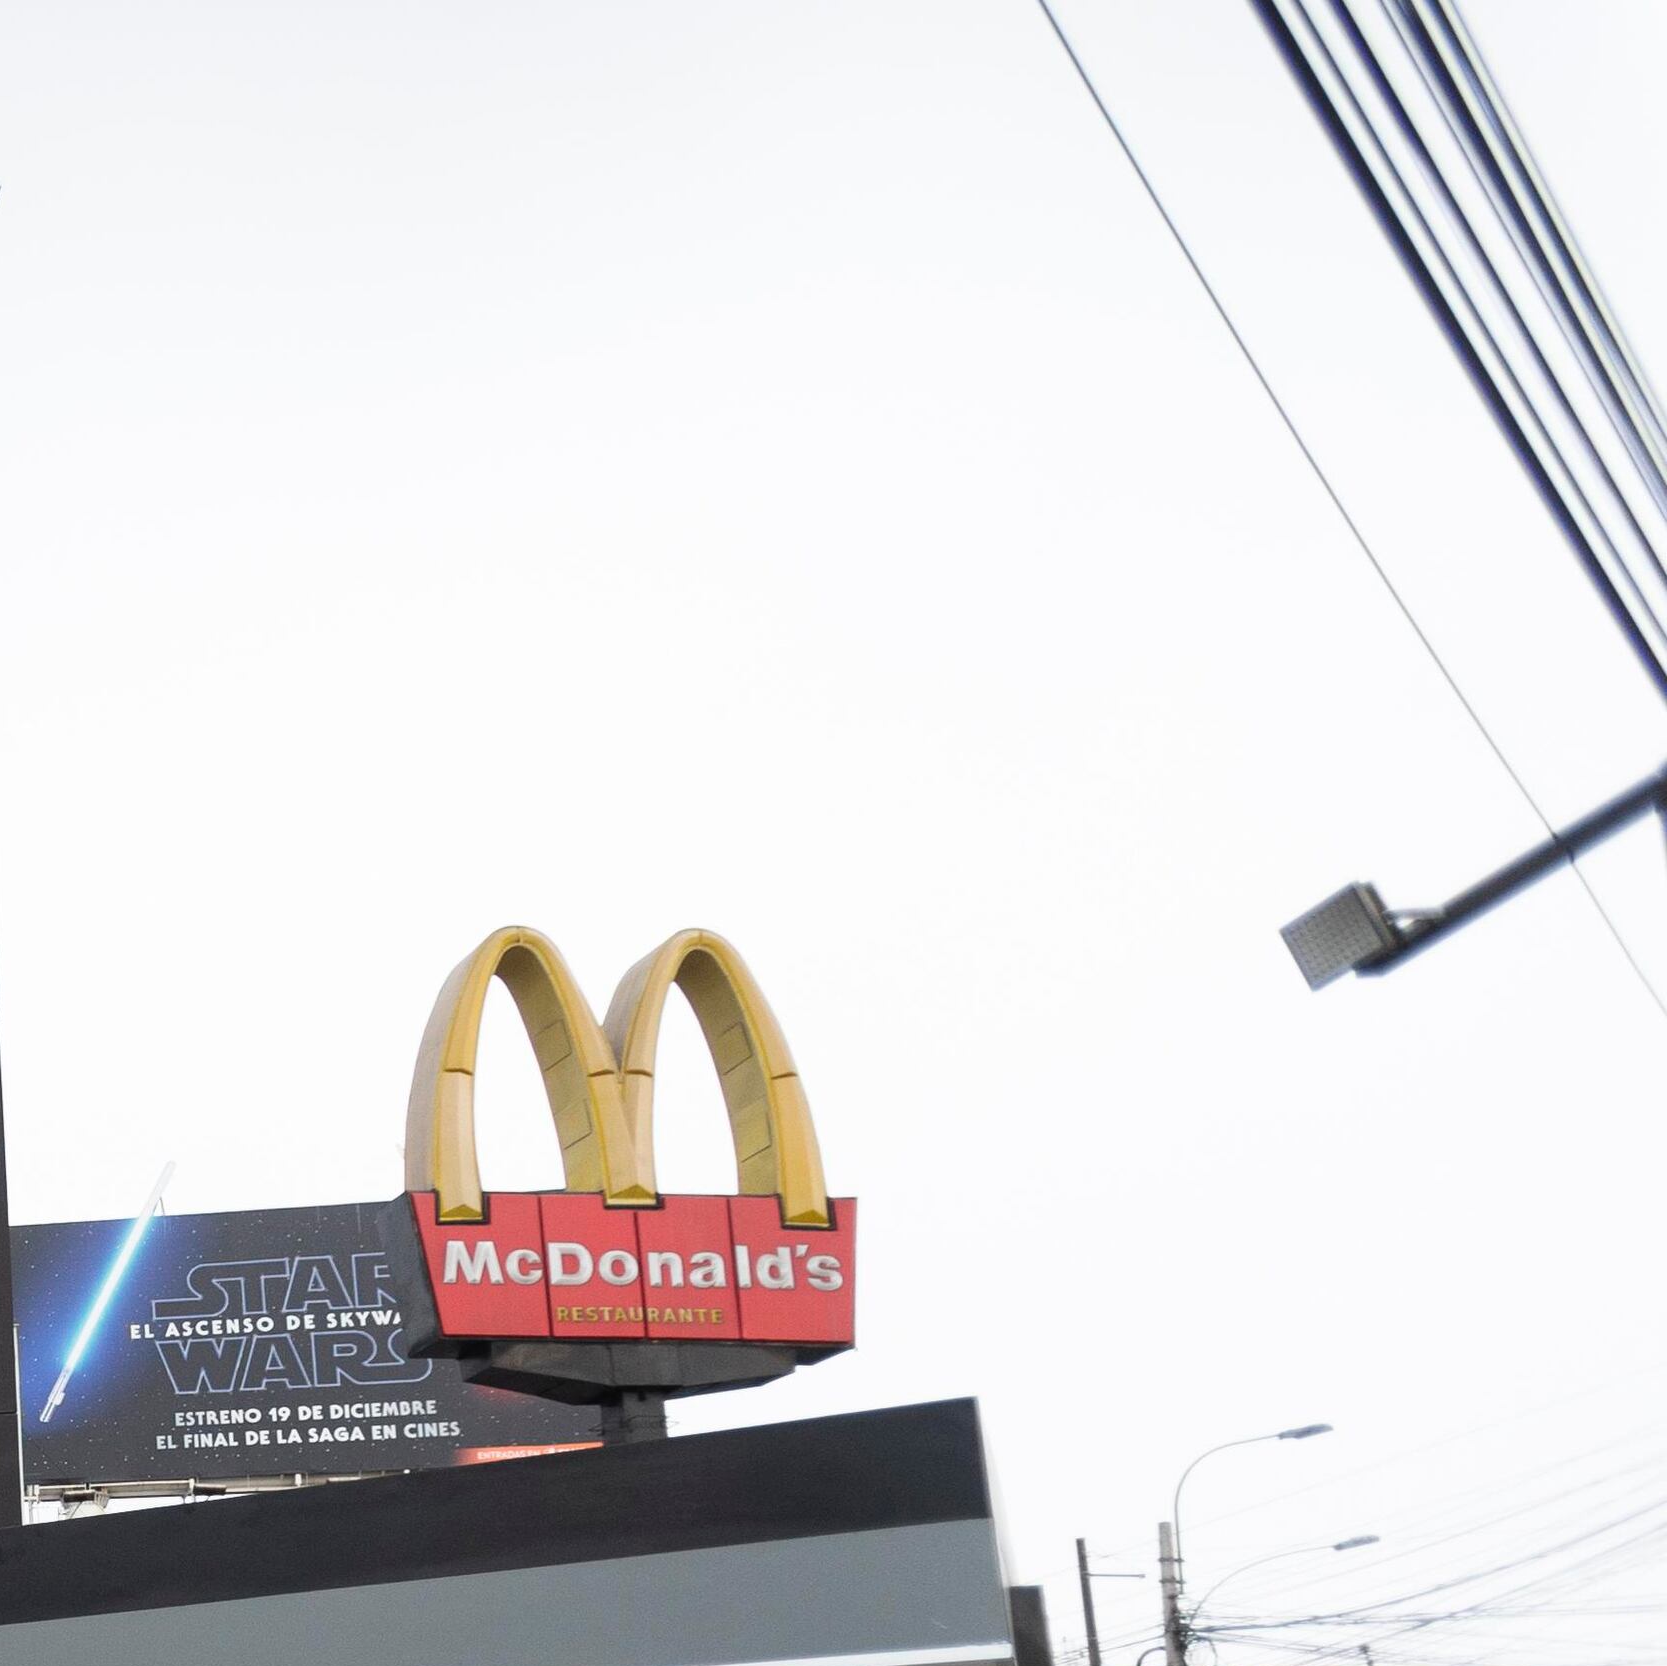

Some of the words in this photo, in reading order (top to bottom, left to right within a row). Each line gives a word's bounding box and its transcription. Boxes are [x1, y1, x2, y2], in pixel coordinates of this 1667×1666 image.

[443, 1240, 844, 1292] McDonald's
[130, 1323, 154, 1340] EL
[164, 1316, 274, 1338] ASCENSO
[287, 1313, 316, 1331] DE
[556, 1306, 725, 1325] RESTAURANTE
[174, 1407, 261, 1427] ESTRENO
[268, 1406, 289, 1423] 19
[298, 1404, 323, 1421] DE
[330, 1399, 437, 1419] DICIEMBRE
[156, 1434, 177, 1450] EL
[182, 1430, 240, 1448] FINAL
[245, 1429, 270, 1446] DE
[277, 1427, 302, 1444] LA
[308, 1424, 364, 1444] SAGA
[371, 1422, 397, 1440] EN
